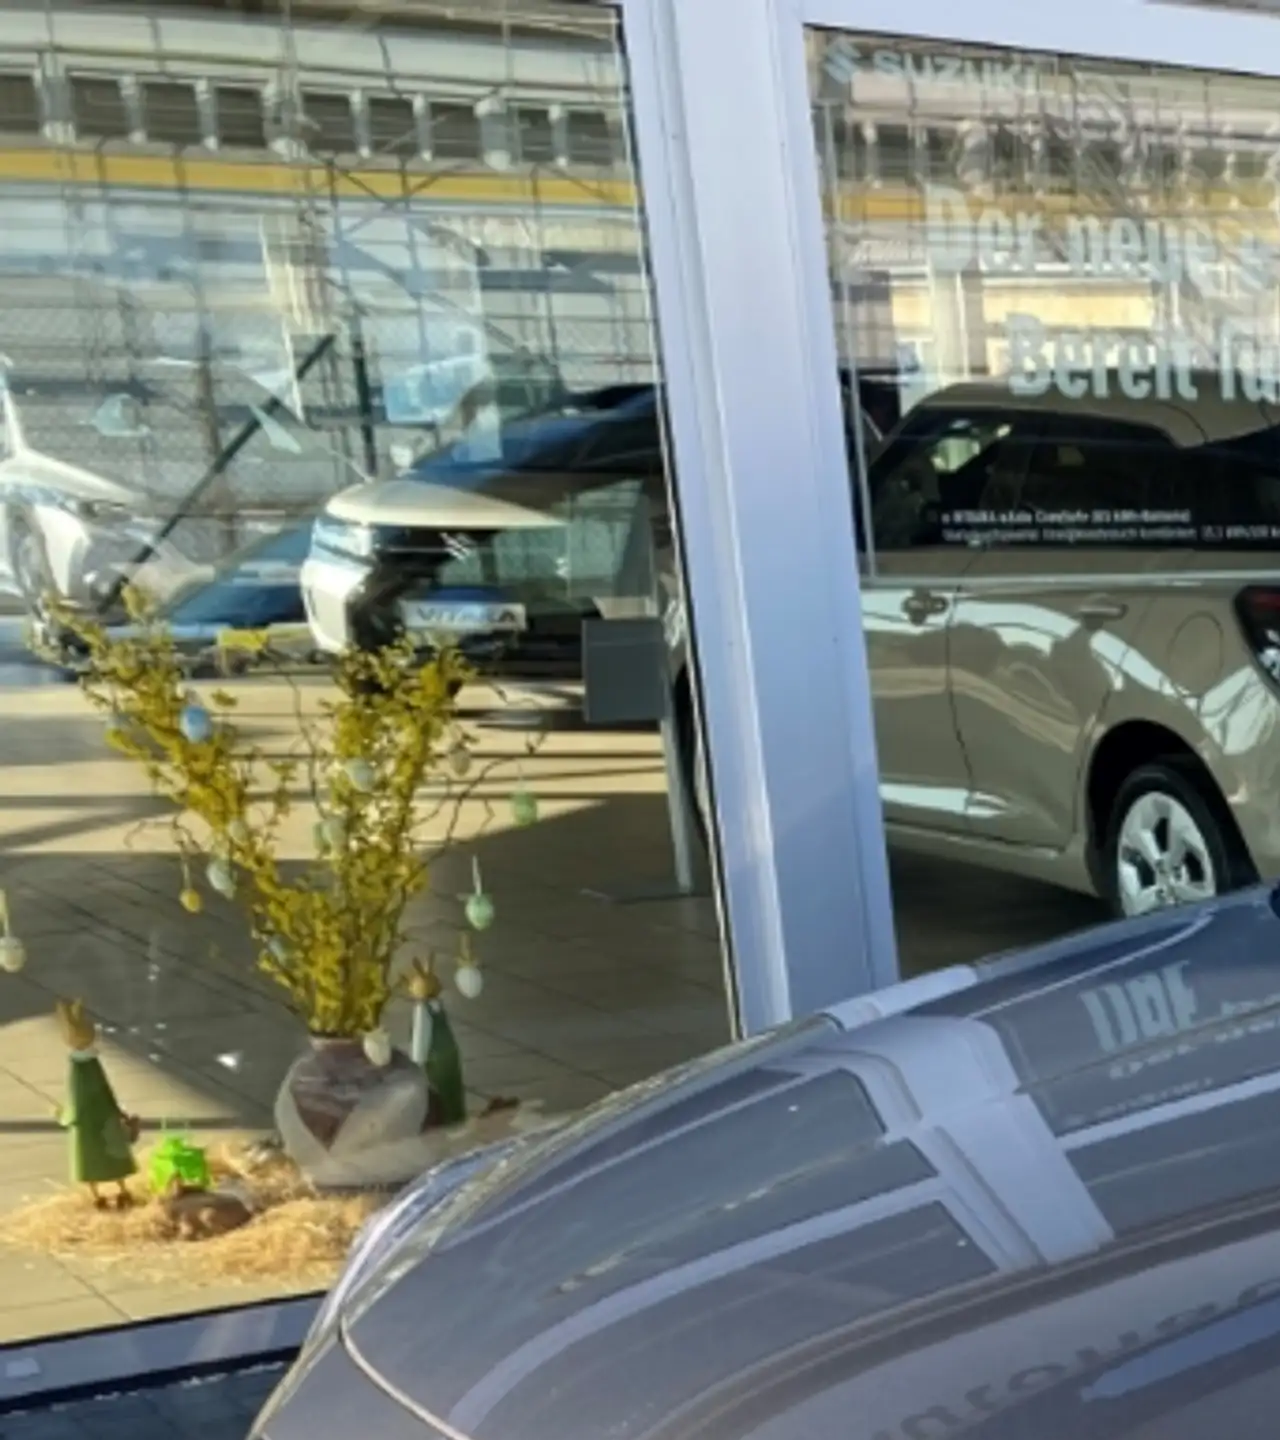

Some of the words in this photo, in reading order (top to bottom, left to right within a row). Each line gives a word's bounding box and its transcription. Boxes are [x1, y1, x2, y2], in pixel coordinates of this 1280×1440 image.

[872, 49, 1041, 96] SUZUKI
[926, 182, 1042, 272] Der
[1005, 311, 1199, 400] Bereit
